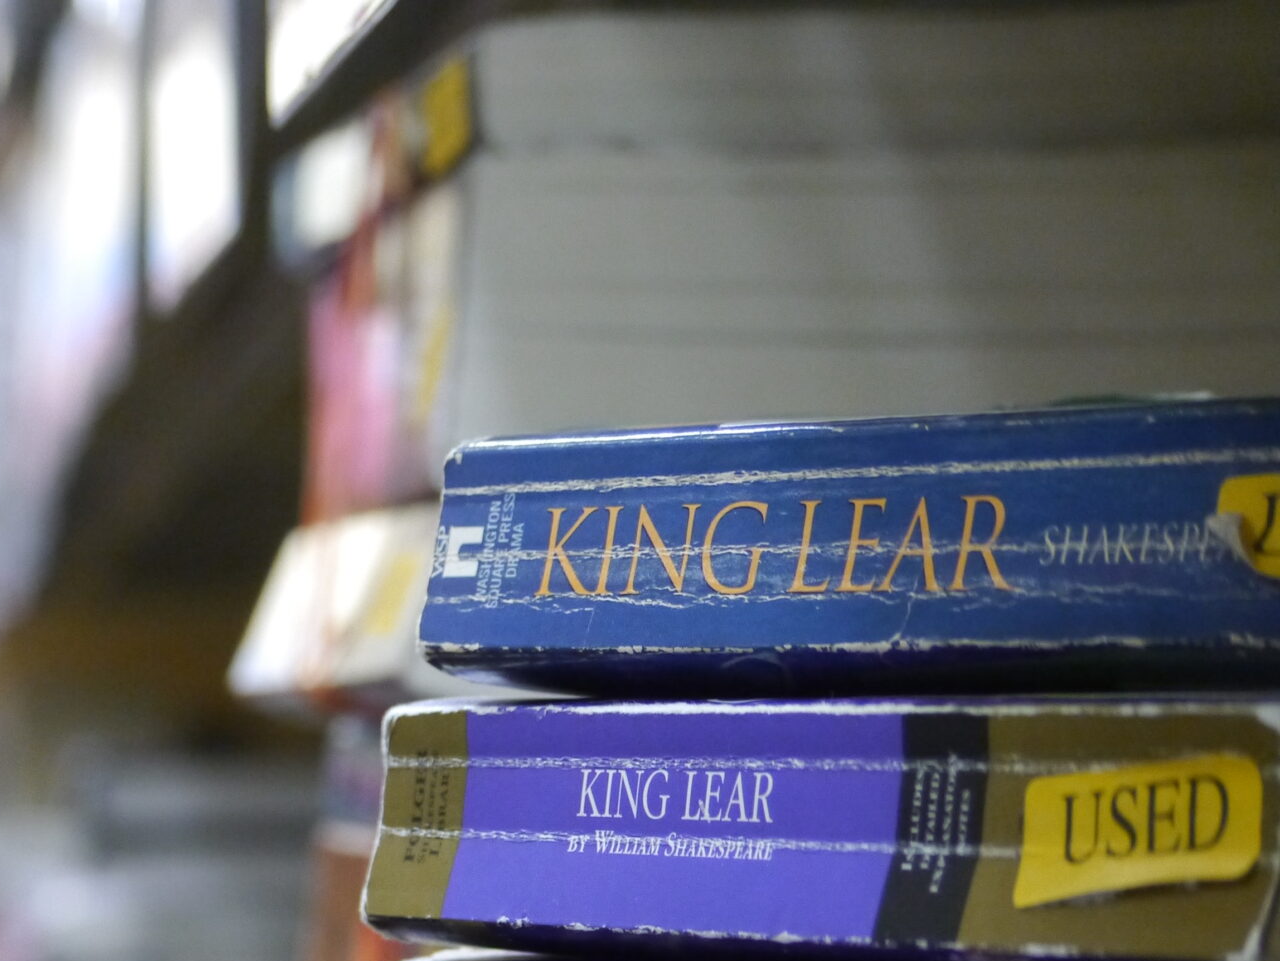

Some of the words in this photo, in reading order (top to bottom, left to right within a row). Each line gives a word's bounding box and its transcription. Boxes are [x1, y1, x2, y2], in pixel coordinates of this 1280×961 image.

[474, 500, 502, 601] WASHINGTON
[484, 548, 508, 608] SQUARE
[498, 492, 516, 543] PRESS
[505, 522, 525, 578] DRAMA
[534, 500, 769, 596] KING
[786, 494, 1018, 593] LEAR
[575, 768, 671, 820] KING
[681, 770, 774, 823] LEAR
[1062, 773, 1230, 864] USED
[567, 833, 589, 853] BY
[594, 829, 663, 857] WILLIAM
[664, 832, 774, 861] SHAKESPEARE
